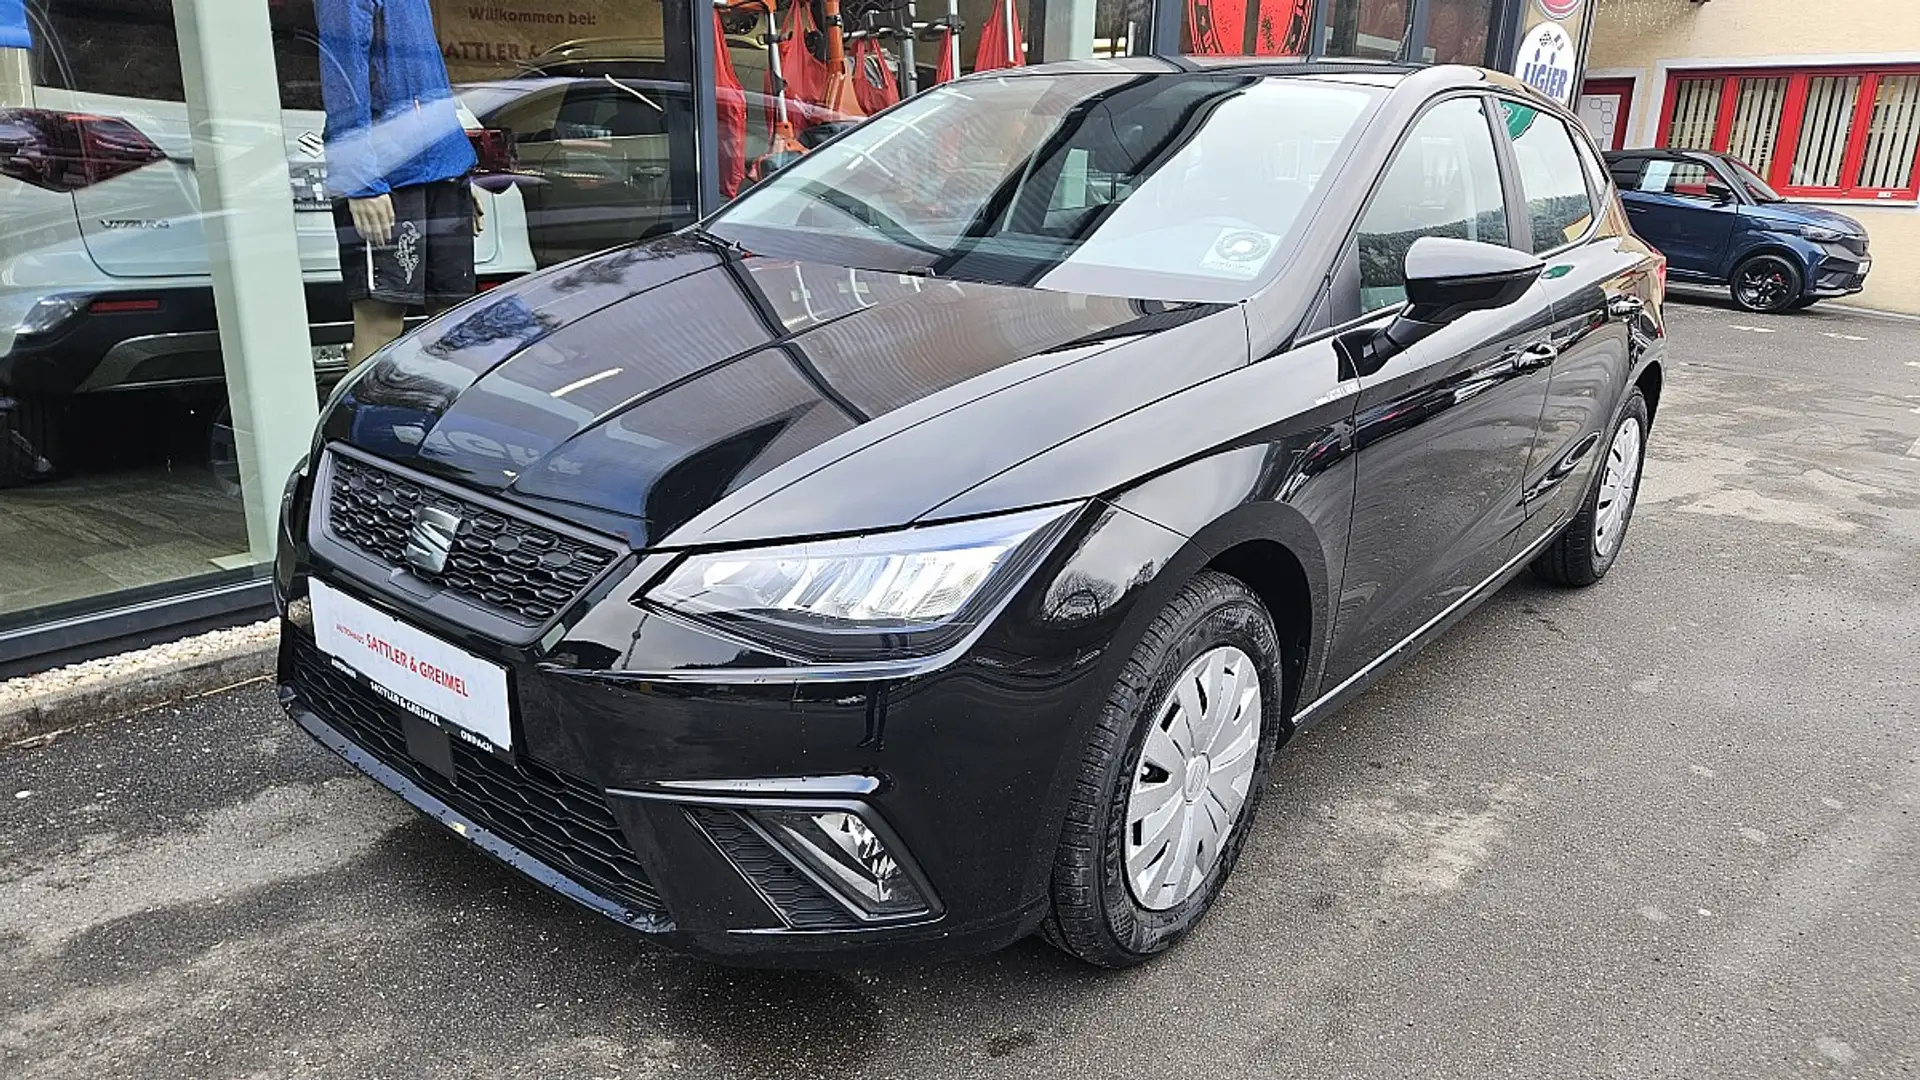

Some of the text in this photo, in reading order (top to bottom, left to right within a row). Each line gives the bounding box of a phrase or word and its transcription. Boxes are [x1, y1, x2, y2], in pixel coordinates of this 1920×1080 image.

[468, 6, 596, 26] Willkommen bei:
[445, 41, 521, 61] ATTLER
[366, 633, 408, 670] SATTLER
[409, 655, 418, 674] &
[419, 661, 469, 698] GREIMEL
